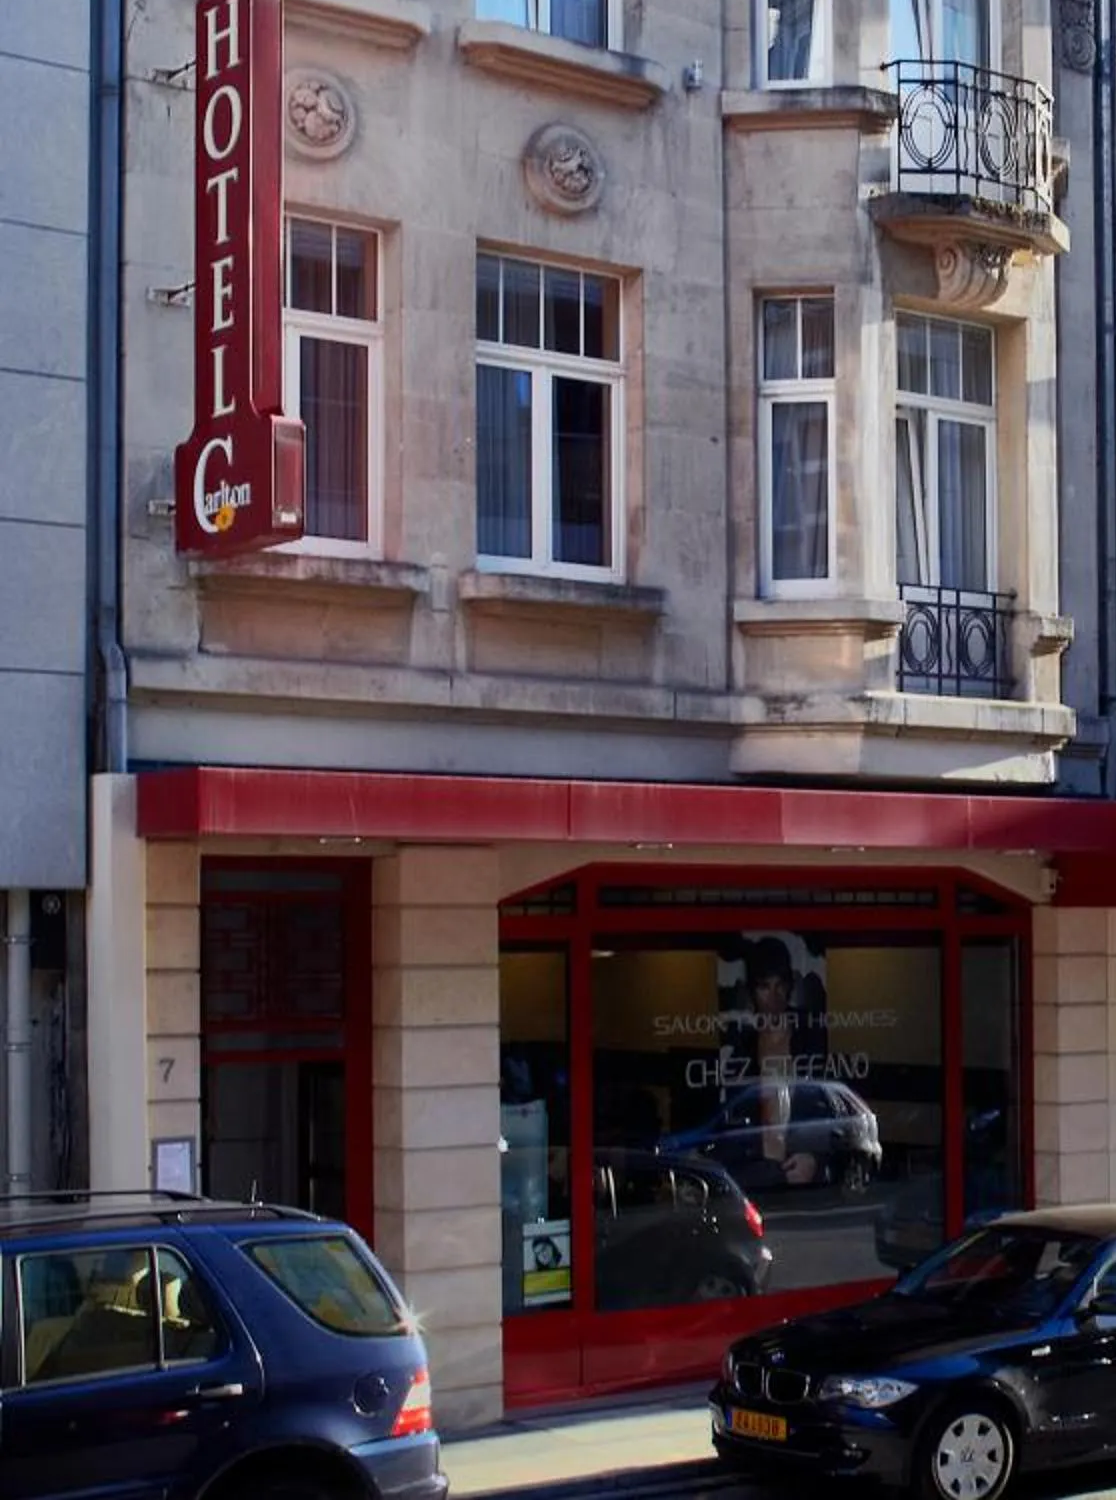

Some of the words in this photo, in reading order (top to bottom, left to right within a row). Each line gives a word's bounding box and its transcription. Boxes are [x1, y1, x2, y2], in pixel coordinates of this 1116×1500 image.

[194, 434, 251, 533] Carlton
[653, 1014, 727, 1037] SALON
[737, 1010, 800, 1032] POUR
[158, 1057, 176, 1084] 7
[685, 1056, 752, 1088] CHEZ
